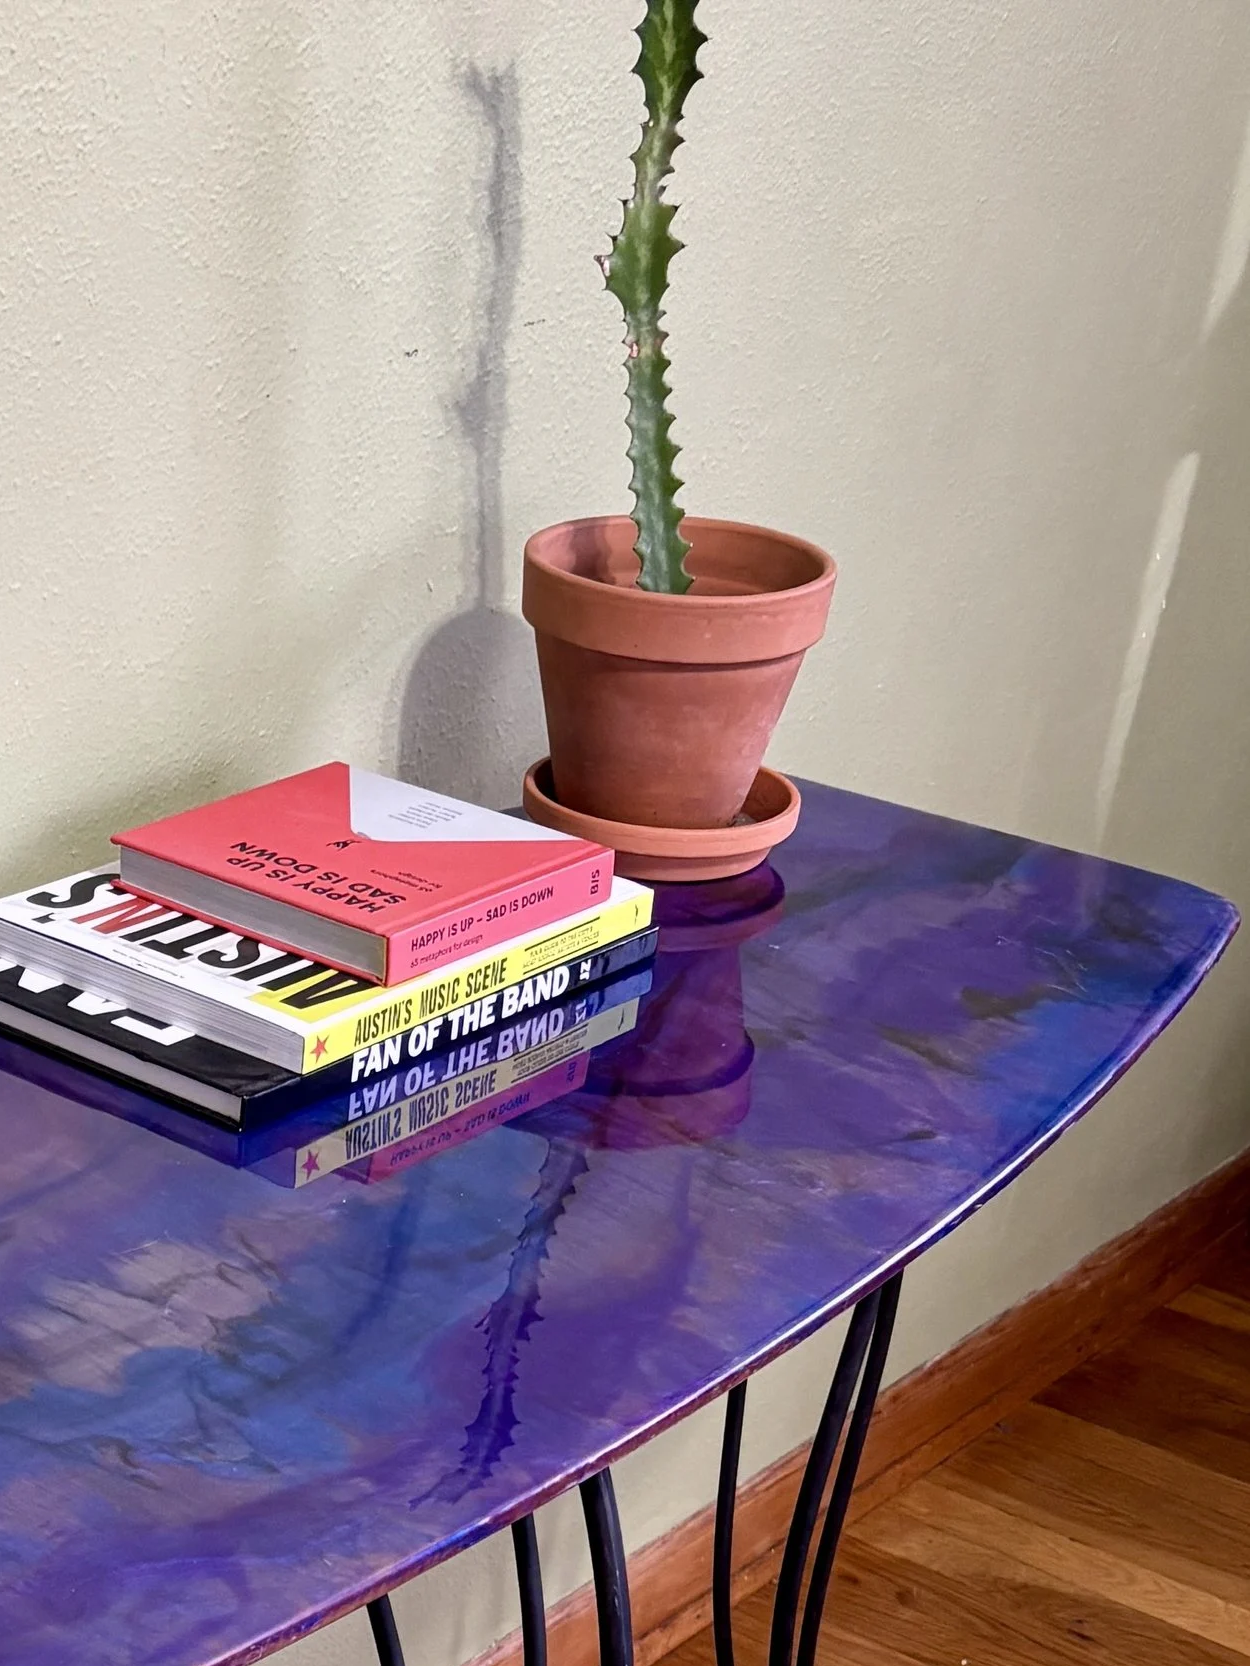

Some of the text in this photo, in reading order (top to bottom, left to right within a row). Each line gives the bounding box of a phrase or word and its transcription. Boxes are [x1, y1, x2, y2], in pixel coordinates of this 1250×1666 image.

[226, 856, 386, 913] HAPPY IS UP
[230, 841, 407, 905] SAD IS DOWN
[590, 869, 600, 895] BIS
[411, 928, 446, 952] HAPPY
[448, 923, 457, 937] IS
[460, 916, 474, 933] UP
[486, 904, 506, 922] SAD
[509, 899, 519, 914] IS
[521, 886, 554, 909] DOWN
[351, 965, 570, 1083] FAN OF THE BAND
[354, 957, 508, 1047] AUSTIN'S MUSIC SCENE
